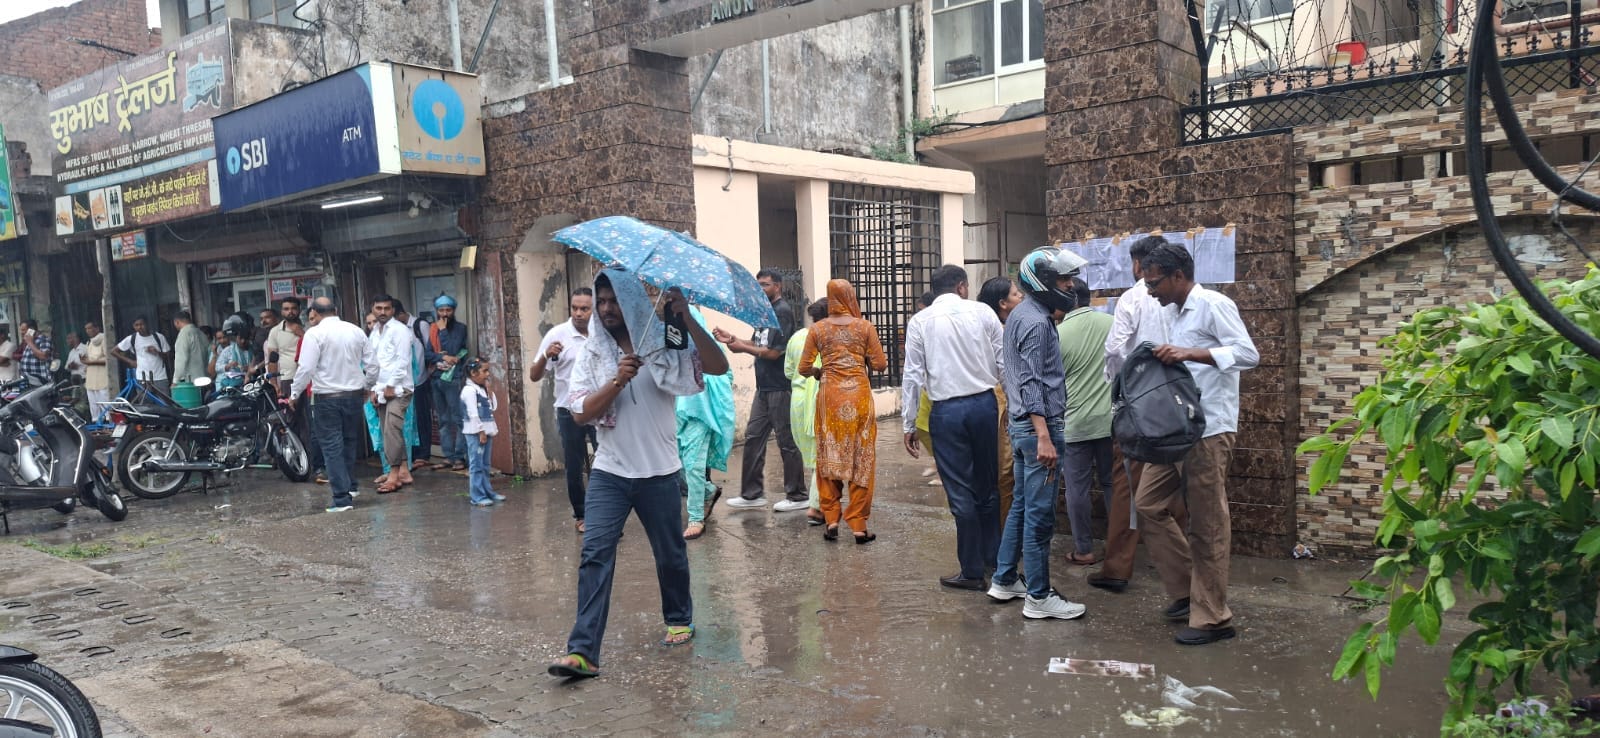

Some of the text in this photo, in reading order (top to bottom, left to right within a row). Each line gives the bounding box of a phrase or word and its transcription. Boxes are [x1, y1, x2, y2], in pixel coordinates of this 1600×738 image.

[49, 51, 177, 154] सुभाष ट्रेलर्ज
[159, 128, 181, 143] WHEAT
[342, 125, 361, 143] ATM
[57, 170, 87, 183] HYDRAULIC
[87, 167, 99, 178] PIPE
[106, 161, 116, 171] ALL
[117, 156, 134, 169] KINDS
[142, 141, 182, 160] AGRICULTURE
[241, 137, 268, 171] SBI
